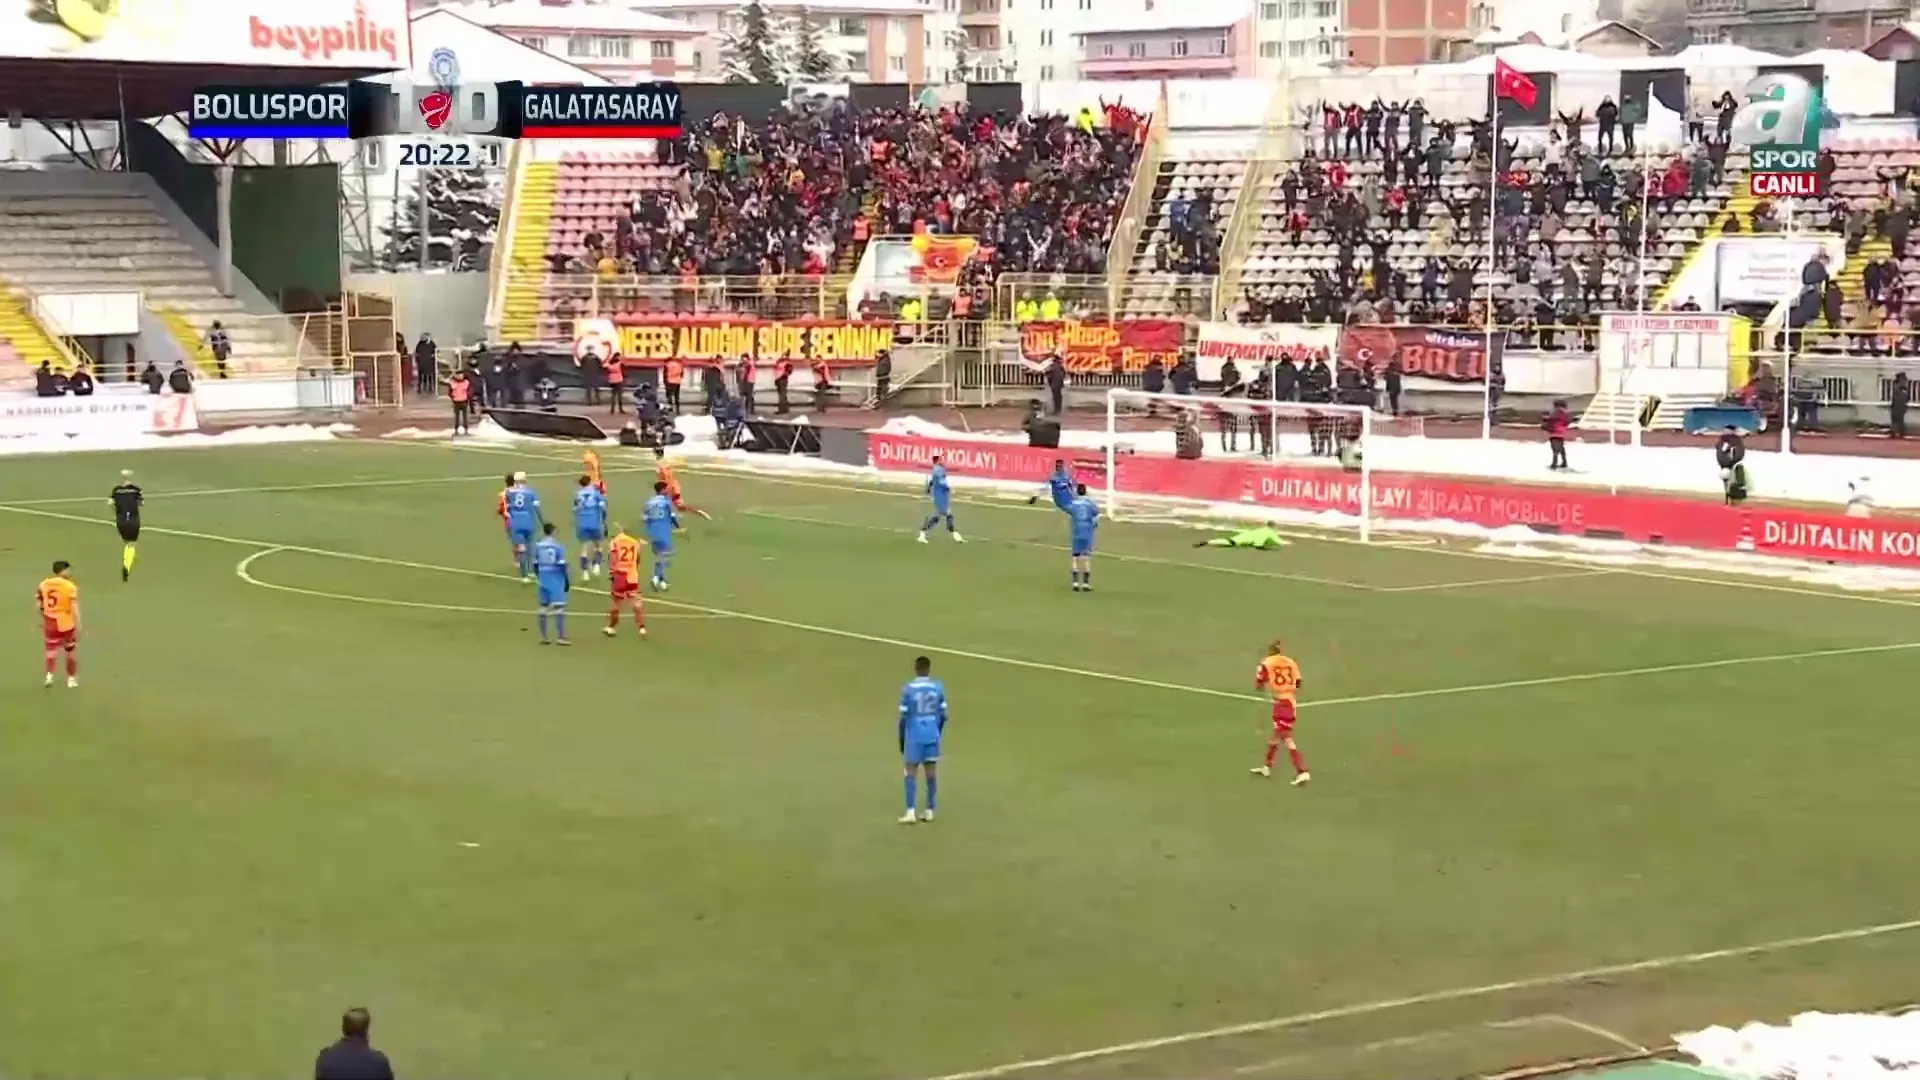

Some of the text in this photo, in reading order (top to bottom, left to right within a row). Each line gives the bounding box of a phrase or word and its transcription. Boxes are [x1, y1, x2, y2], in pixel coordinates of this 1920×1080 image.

[619, 326, 673, 358] NEFES
[945, 449, 997, 472] KOLAYI
[514, 493, 525, 508] 8
[620, 546, 636, 562] 21
[1881, 529, 1920, 557] KO
[47, 588, 58, 608] 5
[1273, 665, 1293, 686] 83
[914, 690, 938, 713] 12
